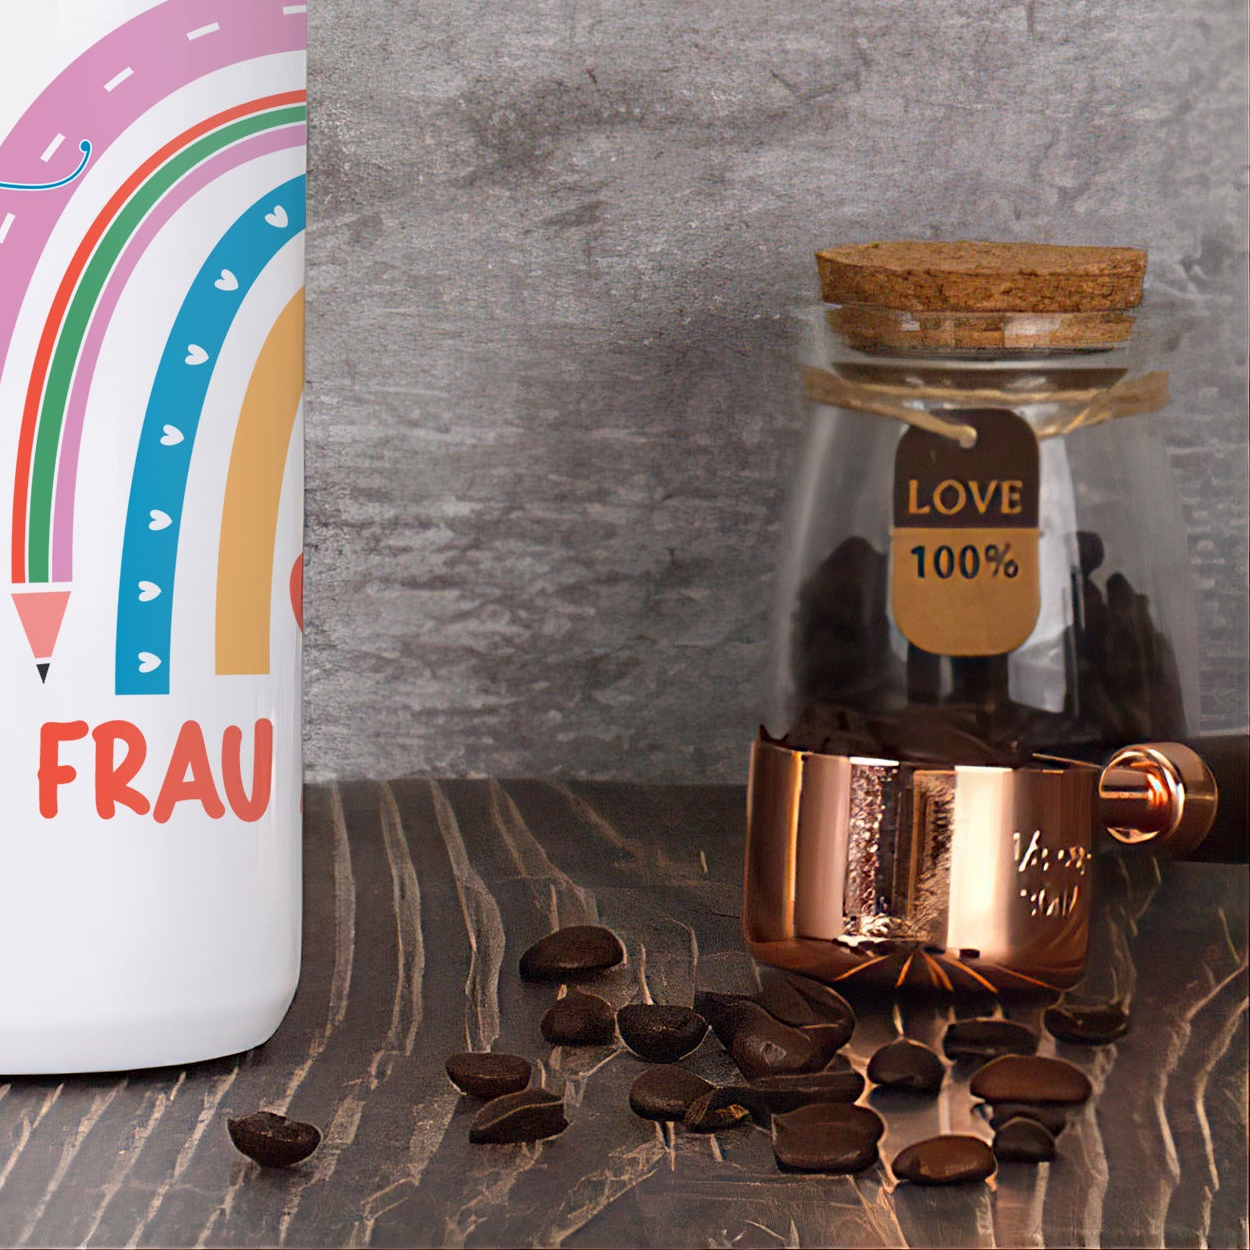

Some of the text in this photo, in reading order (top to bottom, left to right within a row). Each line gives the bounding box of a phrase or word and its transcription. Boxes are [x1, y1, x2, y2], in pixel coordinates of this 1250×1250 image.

[908, 479, 1023, 515] LOVE
[910, 542, 1019, 580] 100%
[37, 717, 274, 824] FRAU
